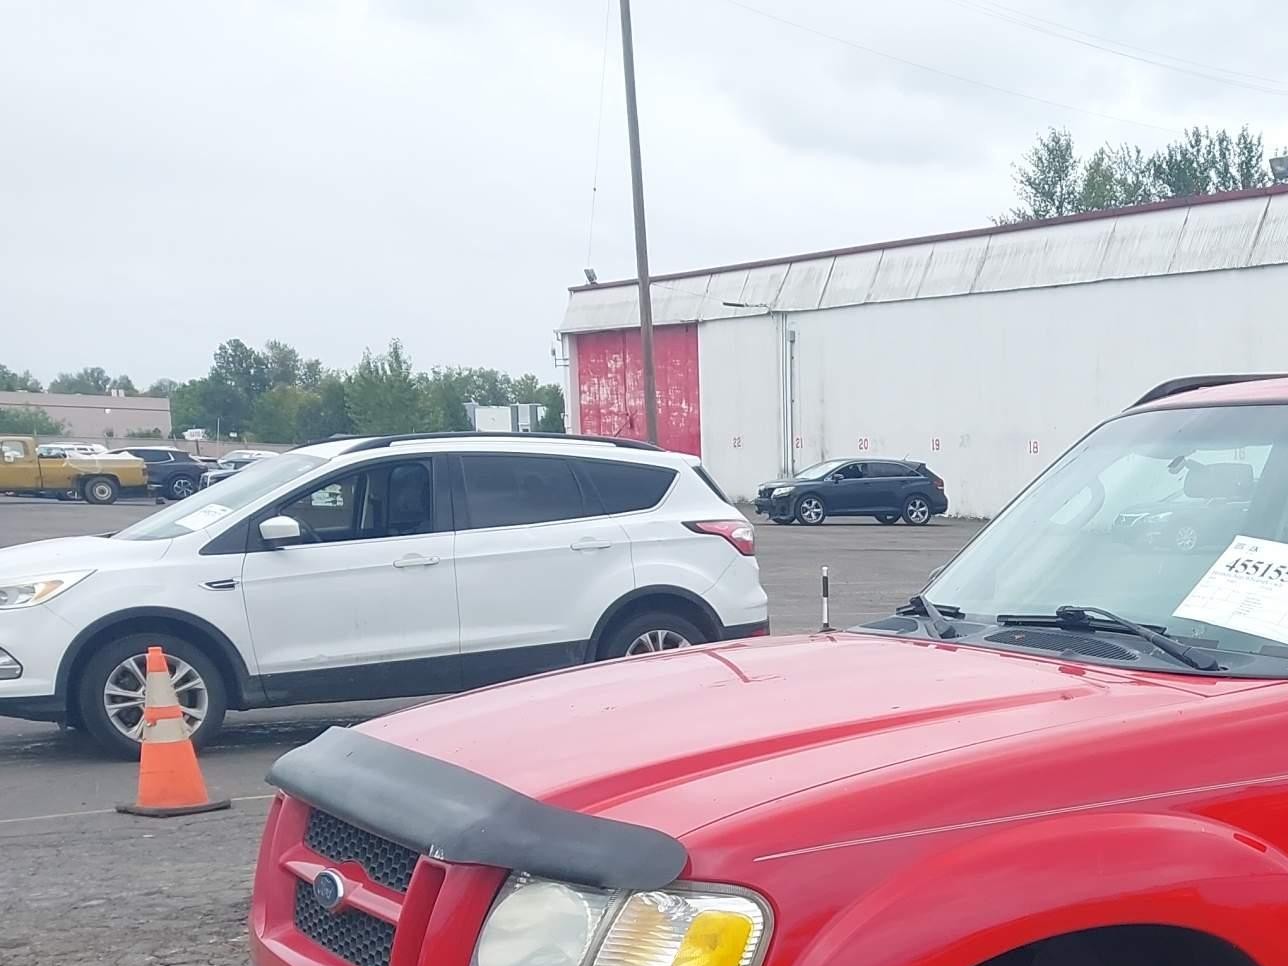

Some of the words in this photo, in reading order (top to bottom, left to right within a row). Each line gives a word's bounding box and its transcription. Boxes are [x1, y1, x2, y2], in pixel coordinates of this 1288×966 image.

[858, 438, 869, 450] 20
[931, 439, 940, 451] 19
[1028, 441, 1039, 454] 18
